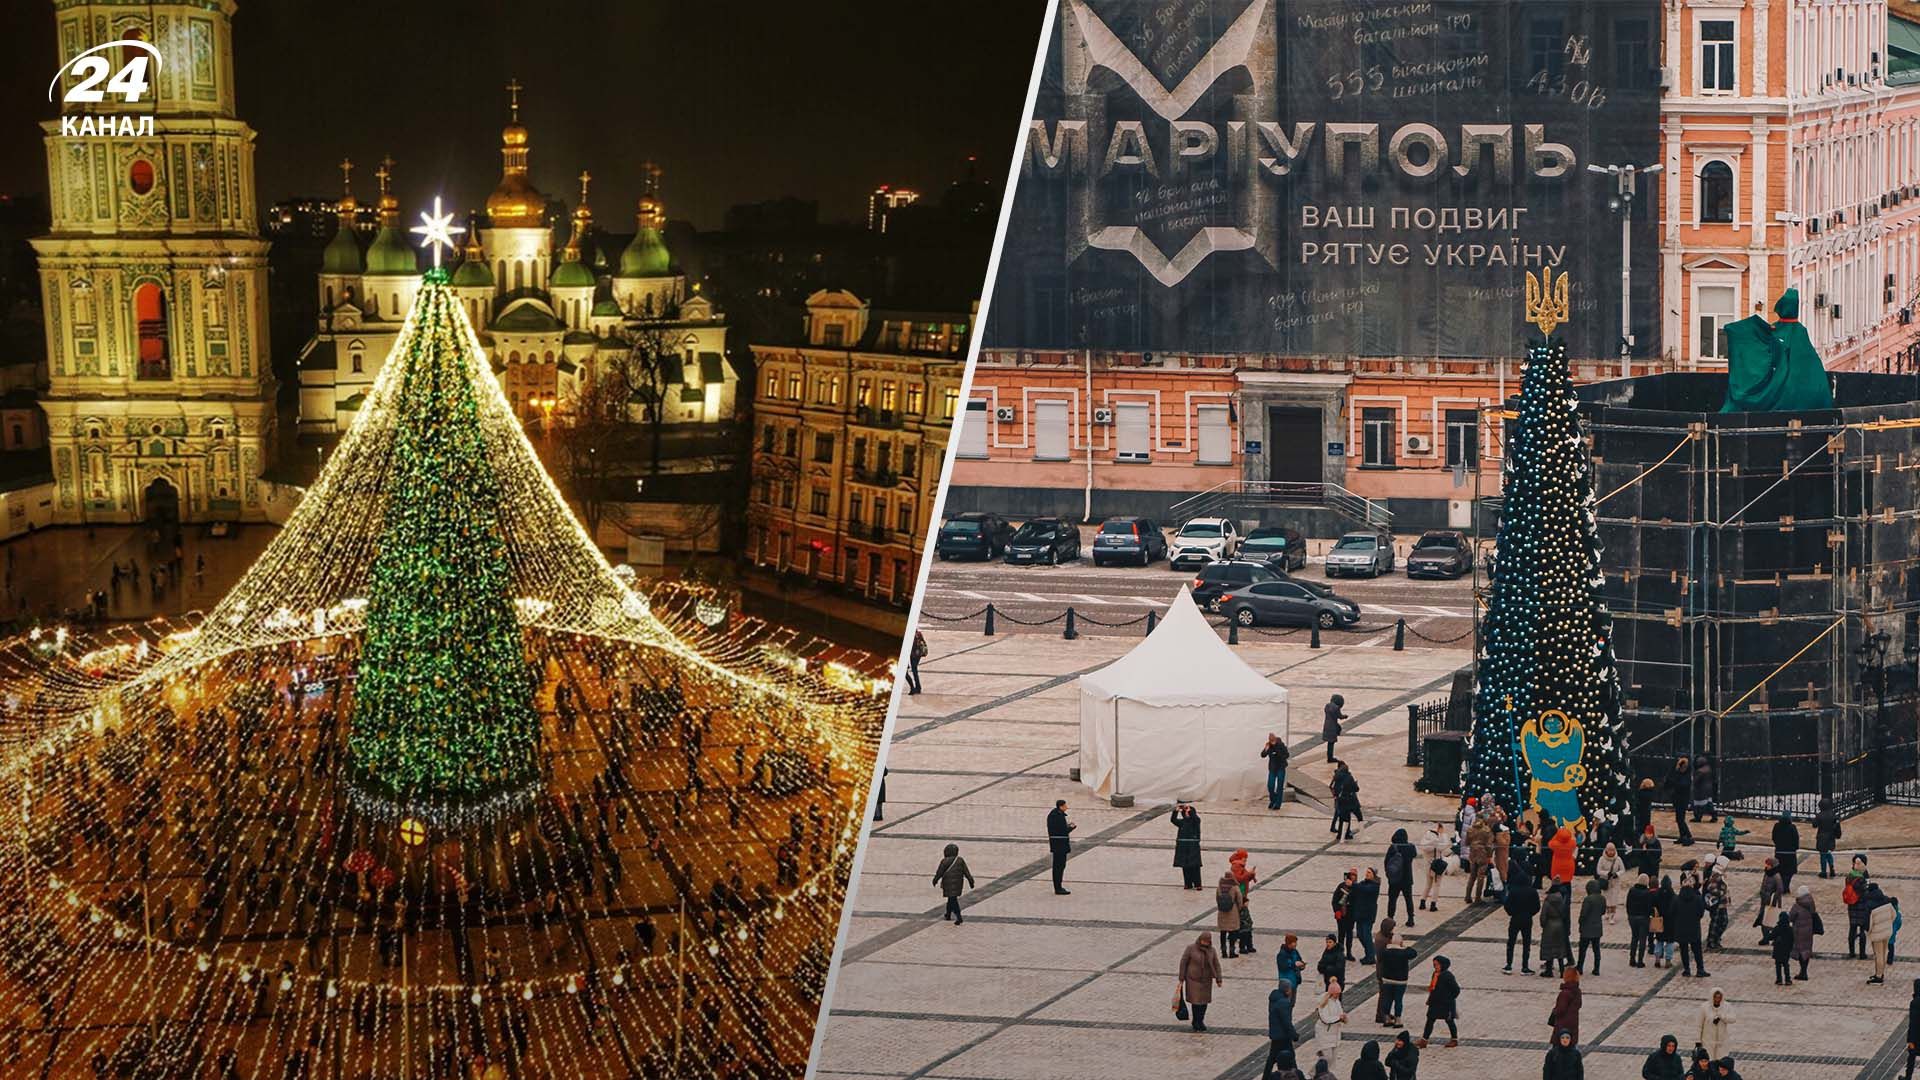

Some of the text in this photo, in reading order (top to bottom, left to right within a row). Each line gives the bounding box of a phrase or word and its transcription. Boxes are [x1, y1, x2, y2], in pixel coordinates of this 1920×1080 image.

[1022, 119, 1577, 178] МАРІУПОЛЬ
[1302, 206, 1528, 234] ВАШ ПОДВИГ
[1302, 237, 1566, 267] РЯТУЄ УКРАЇНУ
